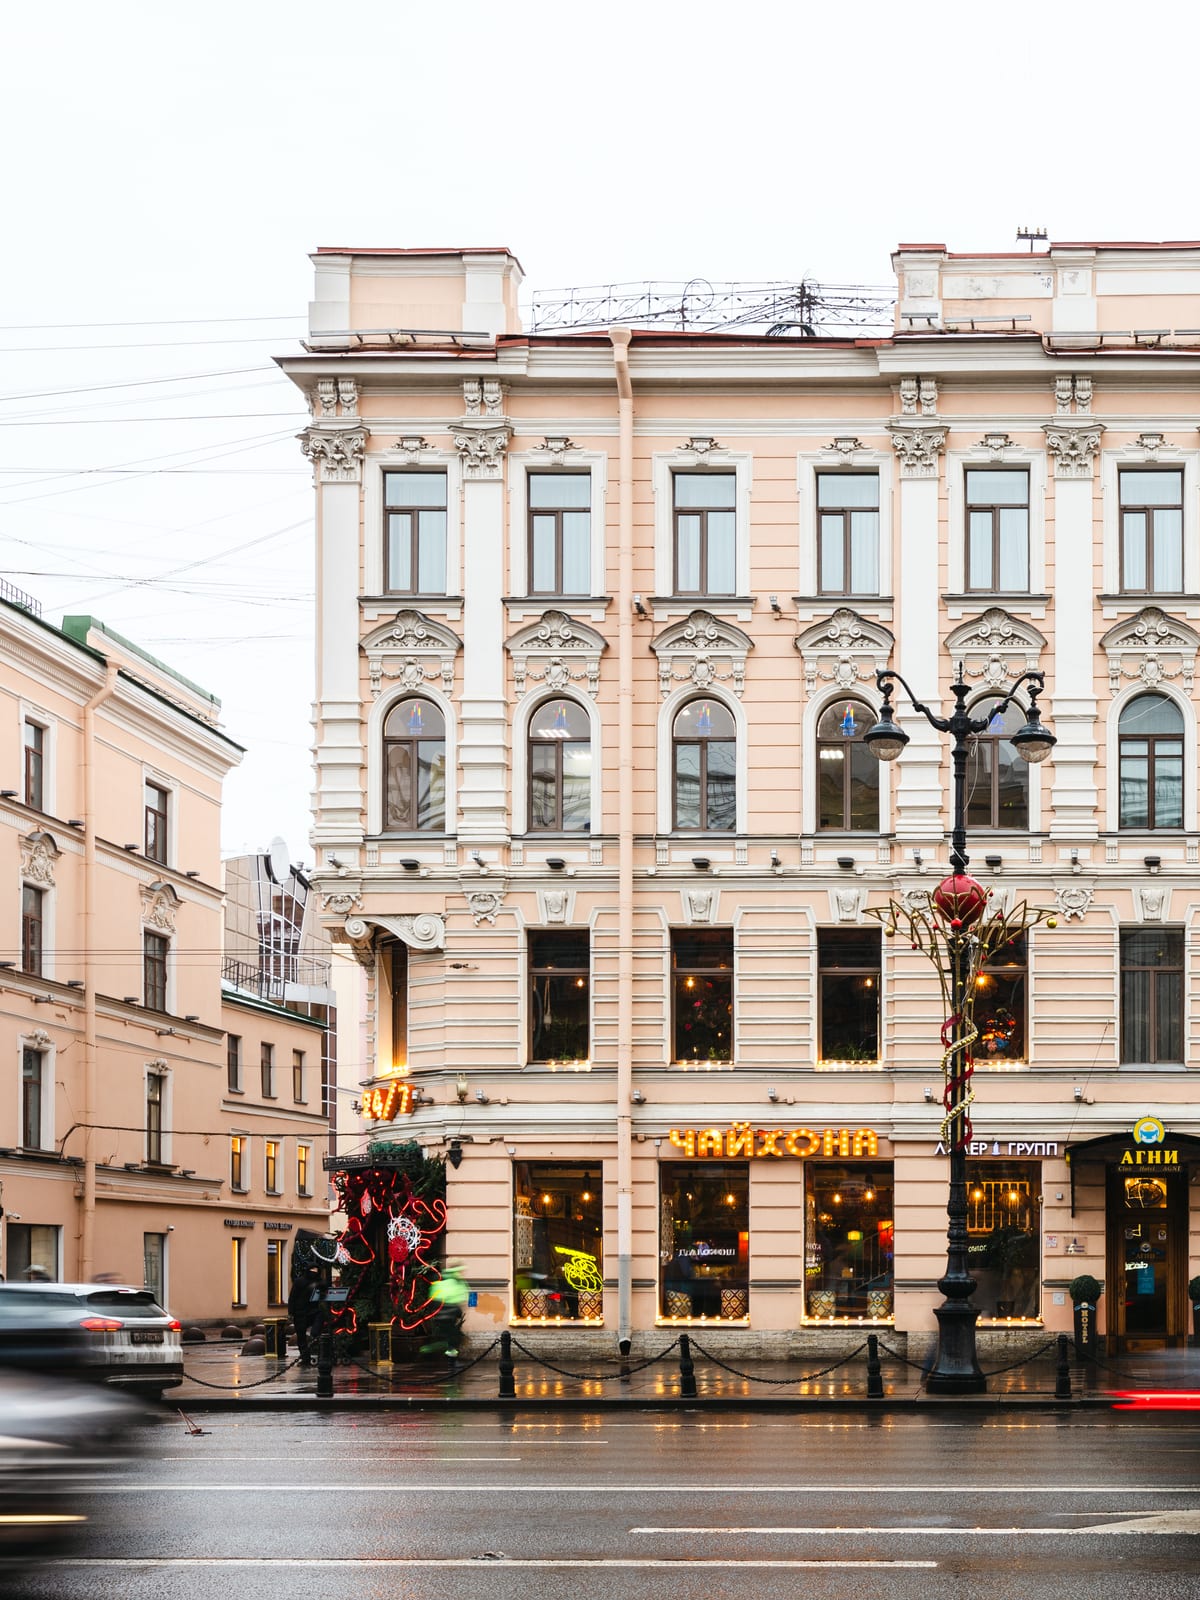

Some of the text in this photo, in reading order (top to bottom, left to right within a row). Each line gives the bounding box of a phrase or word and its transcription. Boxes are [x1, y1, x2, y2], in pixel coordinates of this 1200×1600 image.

[362, 1079, 415, 1121] 24/7
[669, 1122, 878, 1157] ЧАЙХОНА
[934, 1141, 1058, 1156] ЛЕР ГРУПП
[1121, 1150, 1179, 1165] АГНИ
[1081, 1309, 1089, 1344] HOTEL
